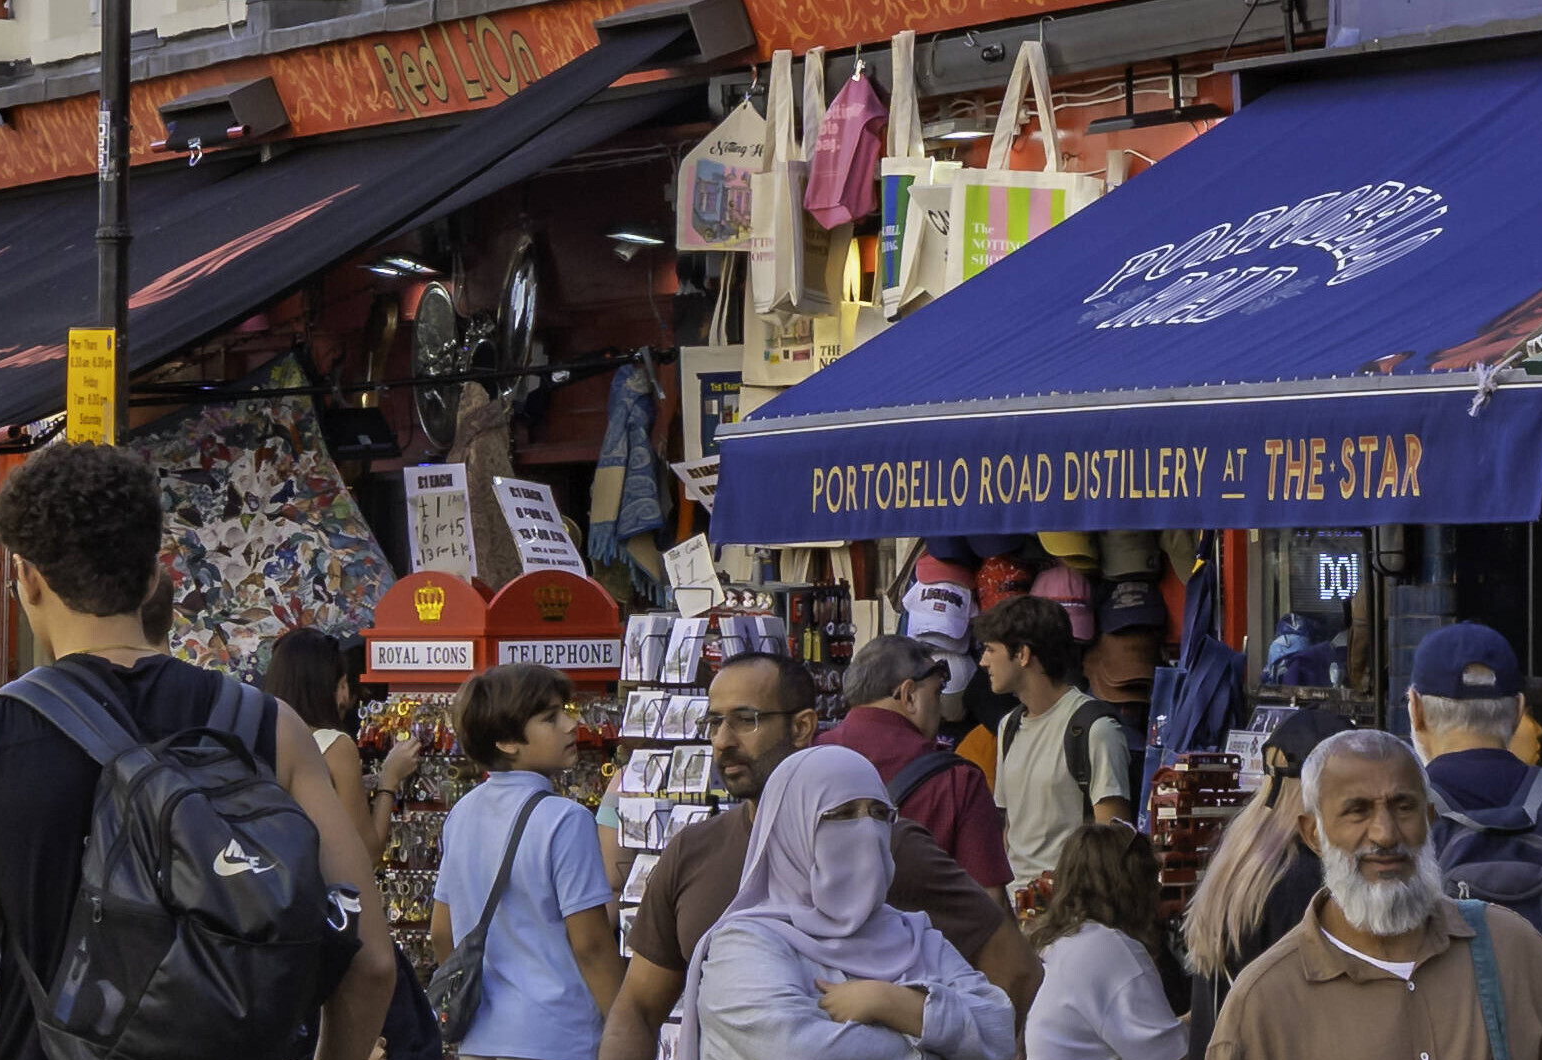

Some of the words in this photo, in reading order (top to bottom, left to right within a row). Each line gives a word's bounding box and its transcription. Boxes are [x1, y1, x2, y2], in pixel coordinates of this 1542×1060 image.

[374, 27, 448, 118] Red
[710, 140, 747, 157] Notting
[749, 143, 763, 157] H
[971, 223, 994, 235] The
[1083, 180, 1448, 287] PORTOBELLO
[970, 254, 1005, 266] SHO
[1096, 266, 1298, 330] ROAD
[820, 345, 841, 357] THE
[429, 473, 454, 488] EACH
[812, 457, 969, 514] PORTOBELLO
[979, 453, 1052, 504] ROAD
[1064, 446, 1208, 502] DISTILLERY
[1223, 448, 1248, 482] AT
[1265, 438, 1326, 501] THE
[1339, 433, 1423, 500] STAR
[522, 487, 544, 502] EACH
[378, 646, 419, 665] ROYAL
[426, 646, 467, 665] ICONS
[507, 643, 613, 666] TELEPHONE
